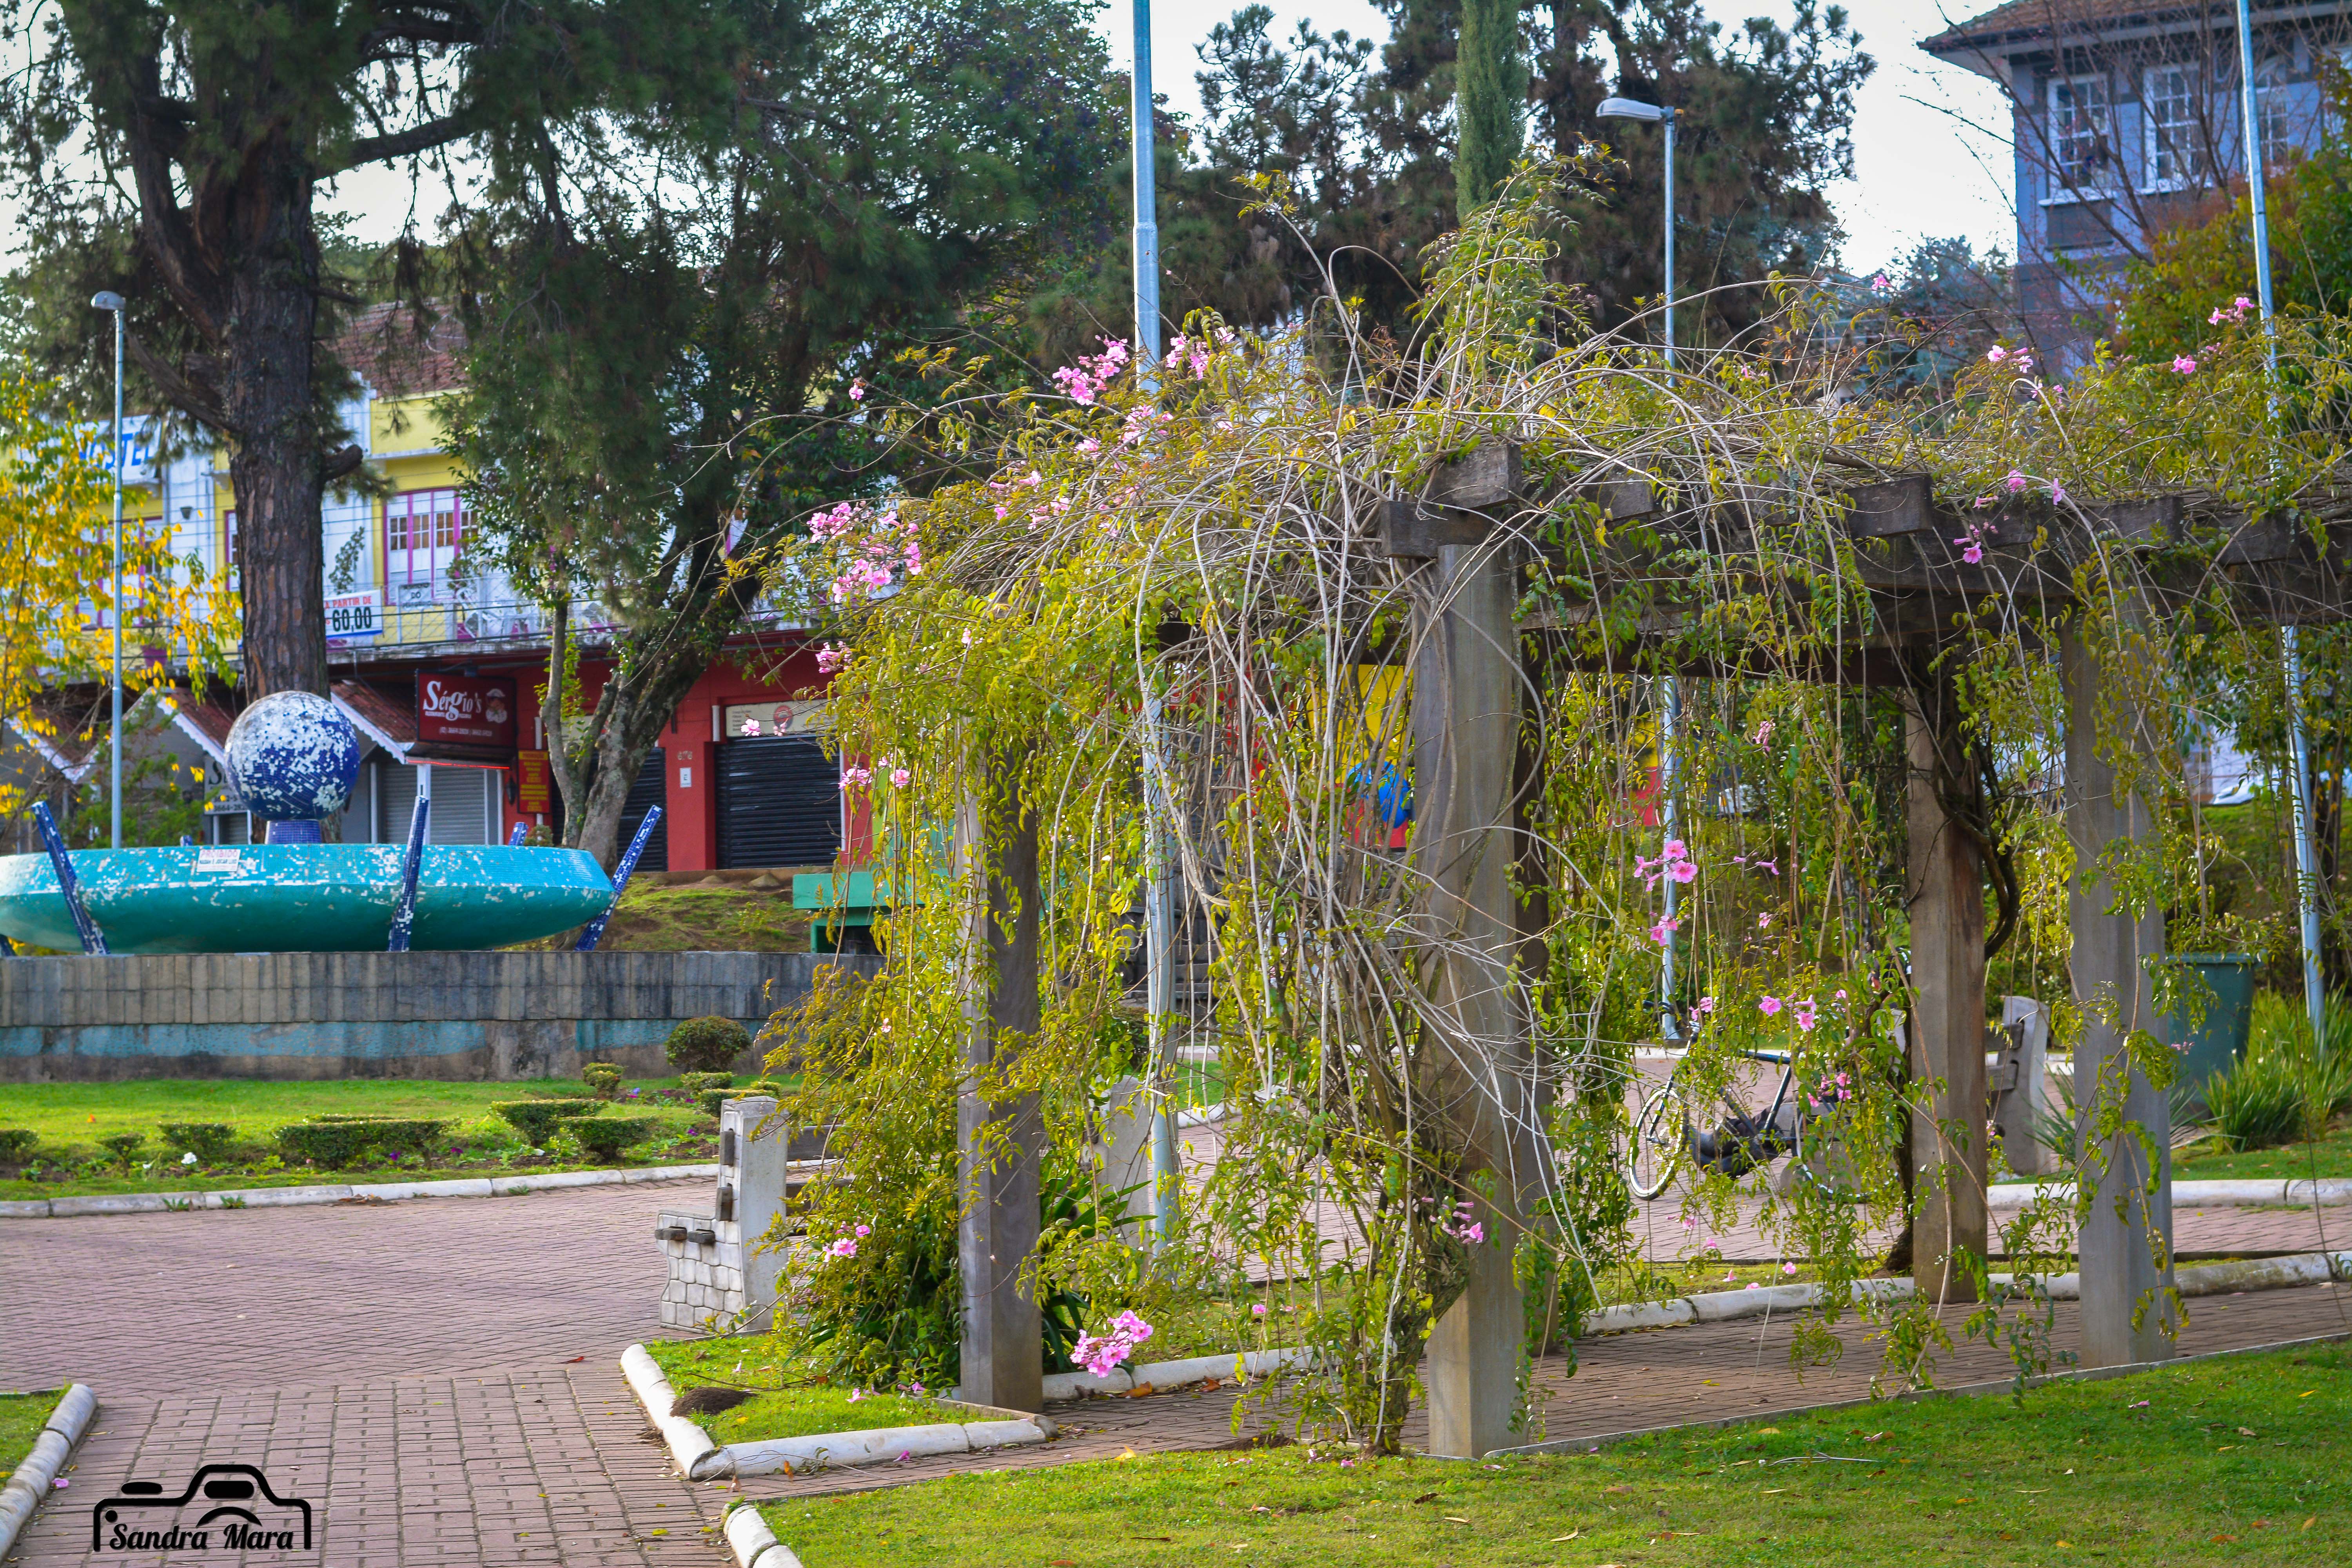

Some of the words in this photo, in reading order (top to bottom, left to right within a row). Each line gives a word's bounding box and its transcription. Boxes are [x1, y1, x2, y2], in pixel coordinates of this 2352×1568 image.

[333, 597, 359, 607] PARTIR
[363, 595, 372, 605] DE
[333, 607, 371, 632] 60,00
[423, 681, 482, 721] Sérgio's
